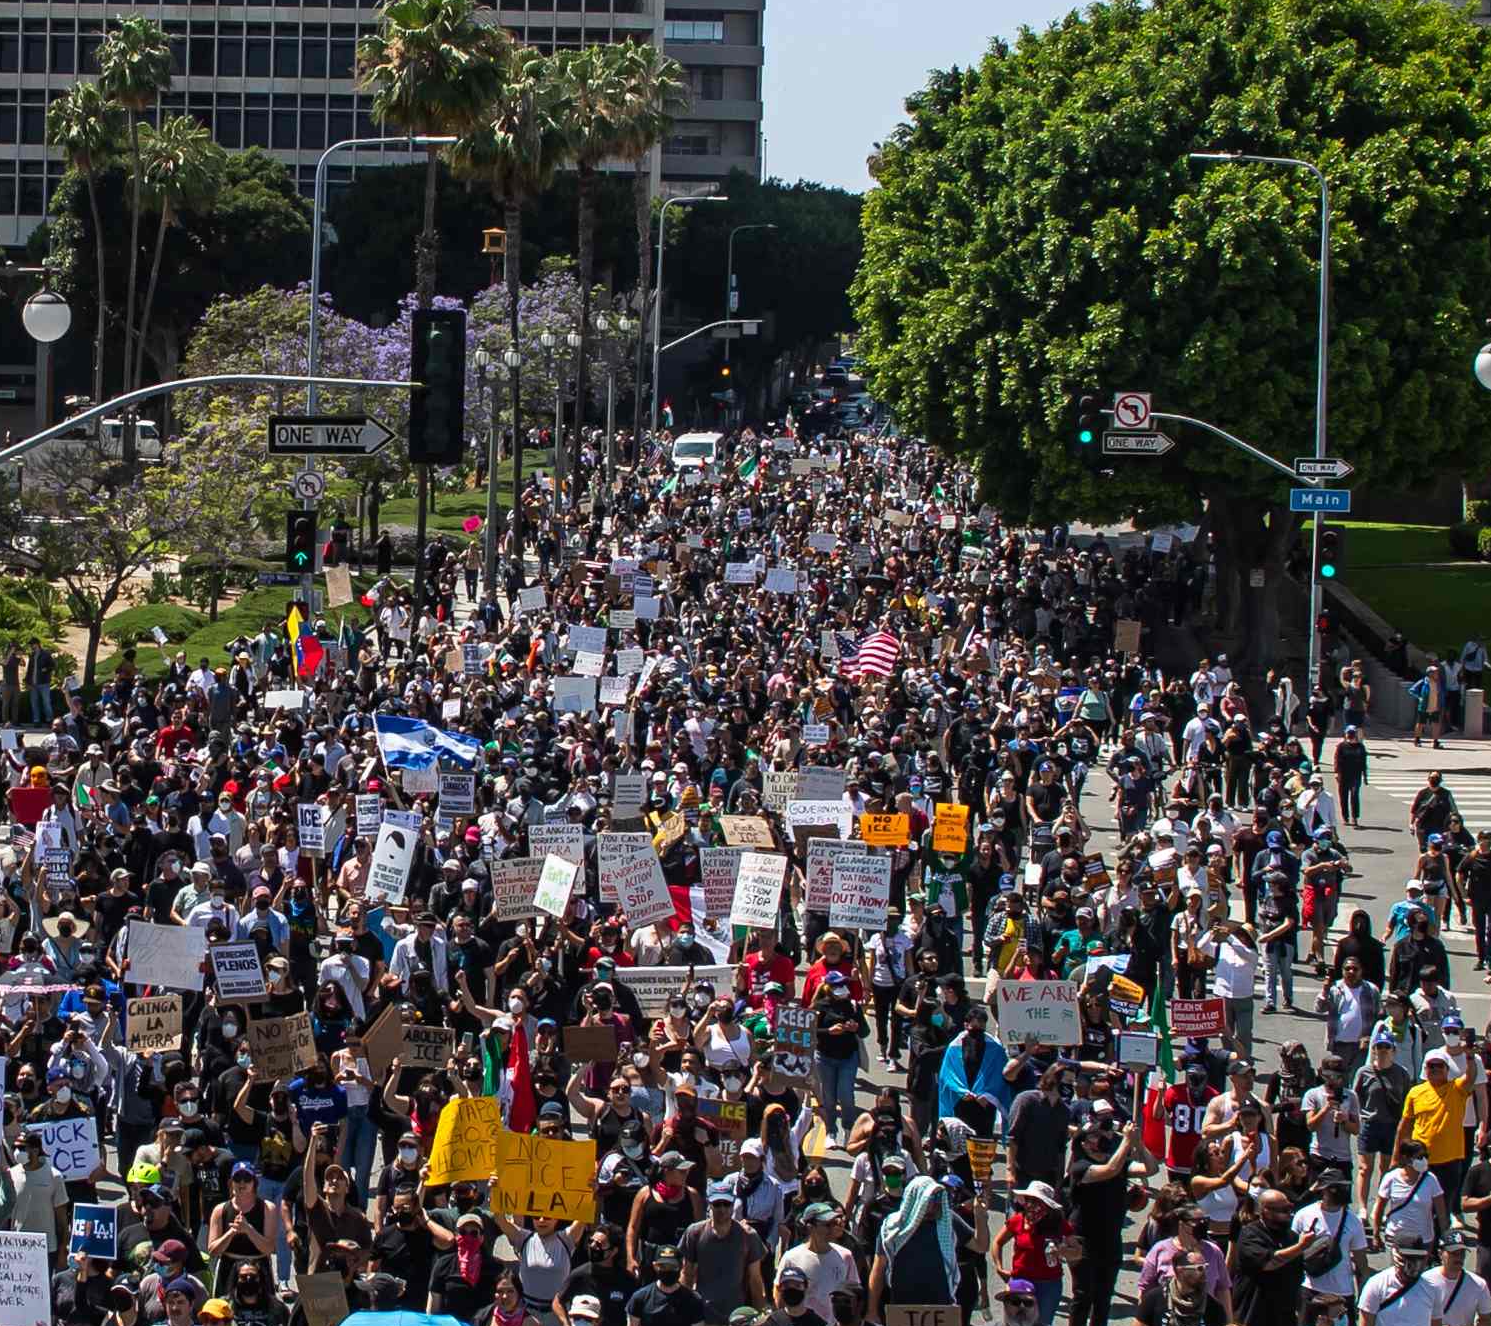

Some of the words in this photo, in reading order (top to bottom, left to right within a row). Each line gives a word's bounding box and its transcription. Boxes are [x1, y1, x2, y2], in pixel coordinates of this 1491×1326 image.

[277, 427, 313, 444] ONE
[327, 426, 362, 444] WAY
[1108, 437, 1128, 448] ONE
[1134, 437, 1156, 449] WAY
[1300, 463, 1314, 472] ONE
[1320, 464, 1336, 472] WAY
[1301, 493, 1340, 505] Main
[529, 826, 546, 836] LOS
[547, 825, 581, 835] ANGELES
[566, 836, 580, 844] SAY
[603, 835, 618, 843] YOU
[621, 834, 648, 843] CAN'T
[532, 845, 572, 856] MIGRA
[852, 857, 886, 865] ANGELES
[839, 873, 883, 885] NATIONAL
[743, 883, 772, 895] ACTION
[841, 884, 872, 893] GUARD
[498, 894, 527, 905] STOP
[627, 891, 654, 907] STOP
[745, 895, 771, 906] STOP
[832, 892, 855, 904] OUT
[857, 894, 888, 907] NOW!
[216, 959, 258, 972] PLENOS
[1002, 987, 1029, 1003] WE
[1041, 985, 1076, 1003] ARE
[128, 1001, 177, 1016] CHINGA
[1026, 1007, 1050, 1020] THE
[146, 1017, 164, 1031] LA
[778, 1008, 814, 1028] KEEP
[256, 1024, 281, 1040] NO
[403, 1029, 454, 1044] ABOLISH
[778, 1028, 811, 1048] ICE
[129, 1032, 176, 1049] MIGRA
[412, 1045, 443, 1062] ICE
[298, 1094, 334, 1111] Dodgers
[518, 1142, 553, 1163] NO
[528, 1162, 577, 1191] ICE
